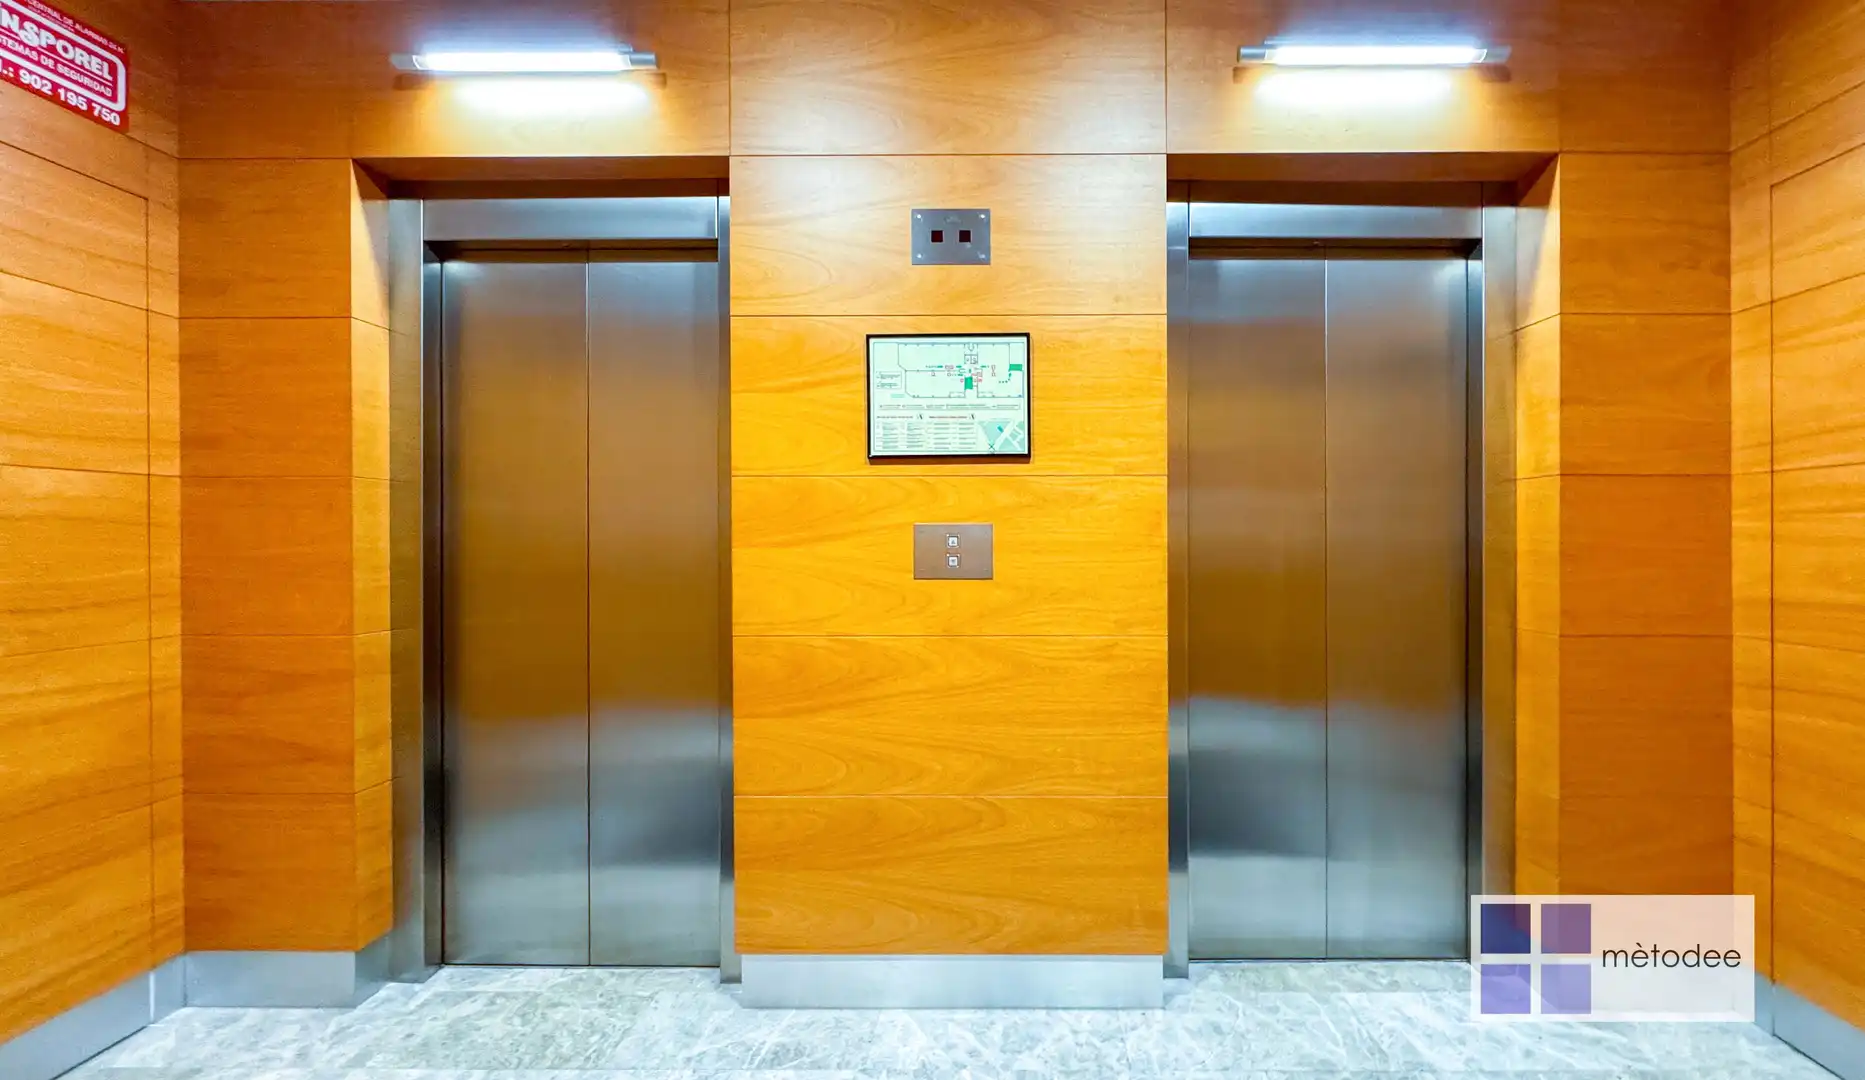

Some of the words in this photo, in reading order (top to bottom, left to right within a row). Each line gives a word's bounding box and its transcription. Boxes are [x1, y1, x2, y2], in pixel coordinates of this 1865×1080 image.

[19, 69, 53, 95] 902
[58, 87, 88, 111] 195
[92, 102, 121, 126] 750
[40, 55, 55, 69] DE
[56, 63, 113, 97] SEGURIDAD
